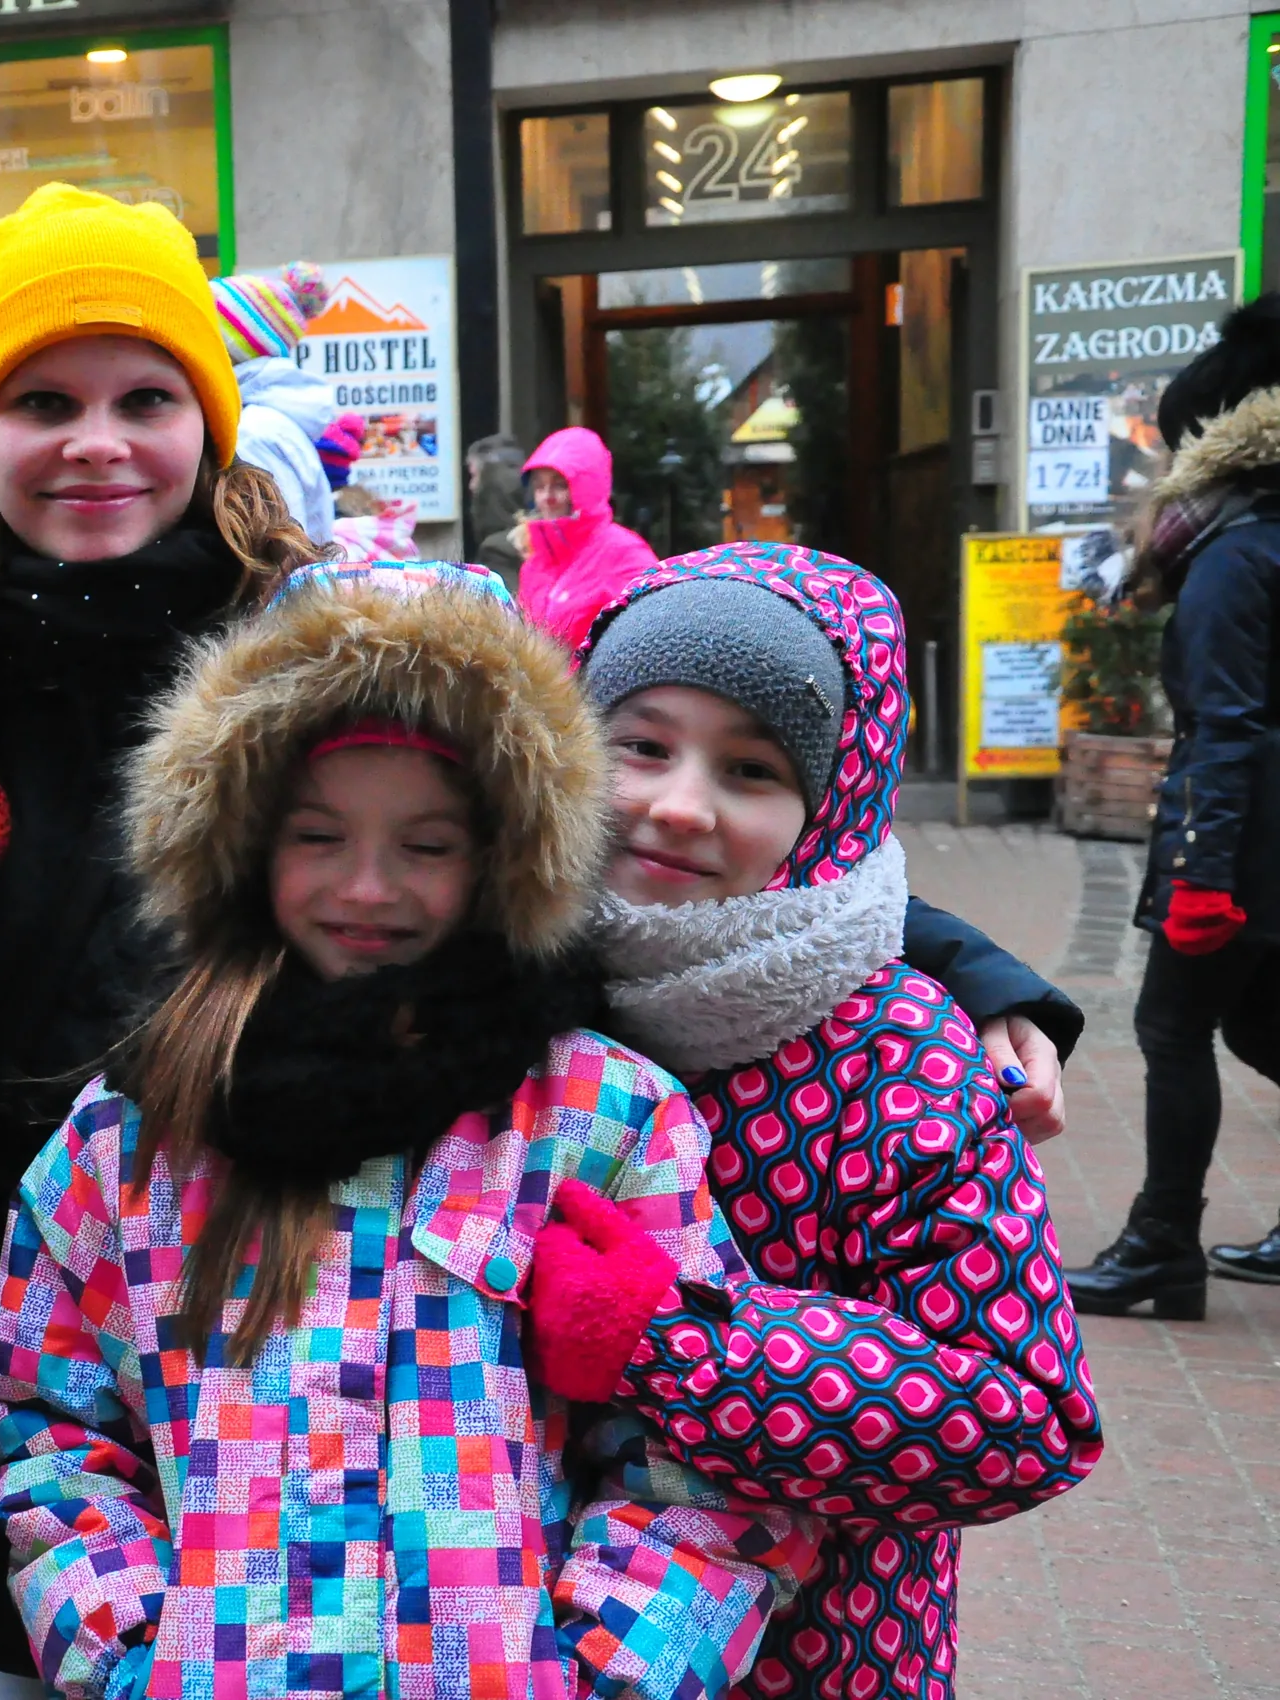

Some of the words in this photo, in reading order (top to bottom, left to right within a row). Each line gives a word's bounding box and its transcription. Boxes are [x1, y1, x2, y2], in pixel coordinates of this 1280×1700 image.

[683, 116, 802, 204] 24
[1034, 270, 1227, 314] KARCZMA
[324, 337, 436, 373] HOSTEL
[1034, 321, 1222, 364] ZAGRODA
[1037, 401, 1103, 422] DANIE
[1043, 423, 1096, 445] DNIA
